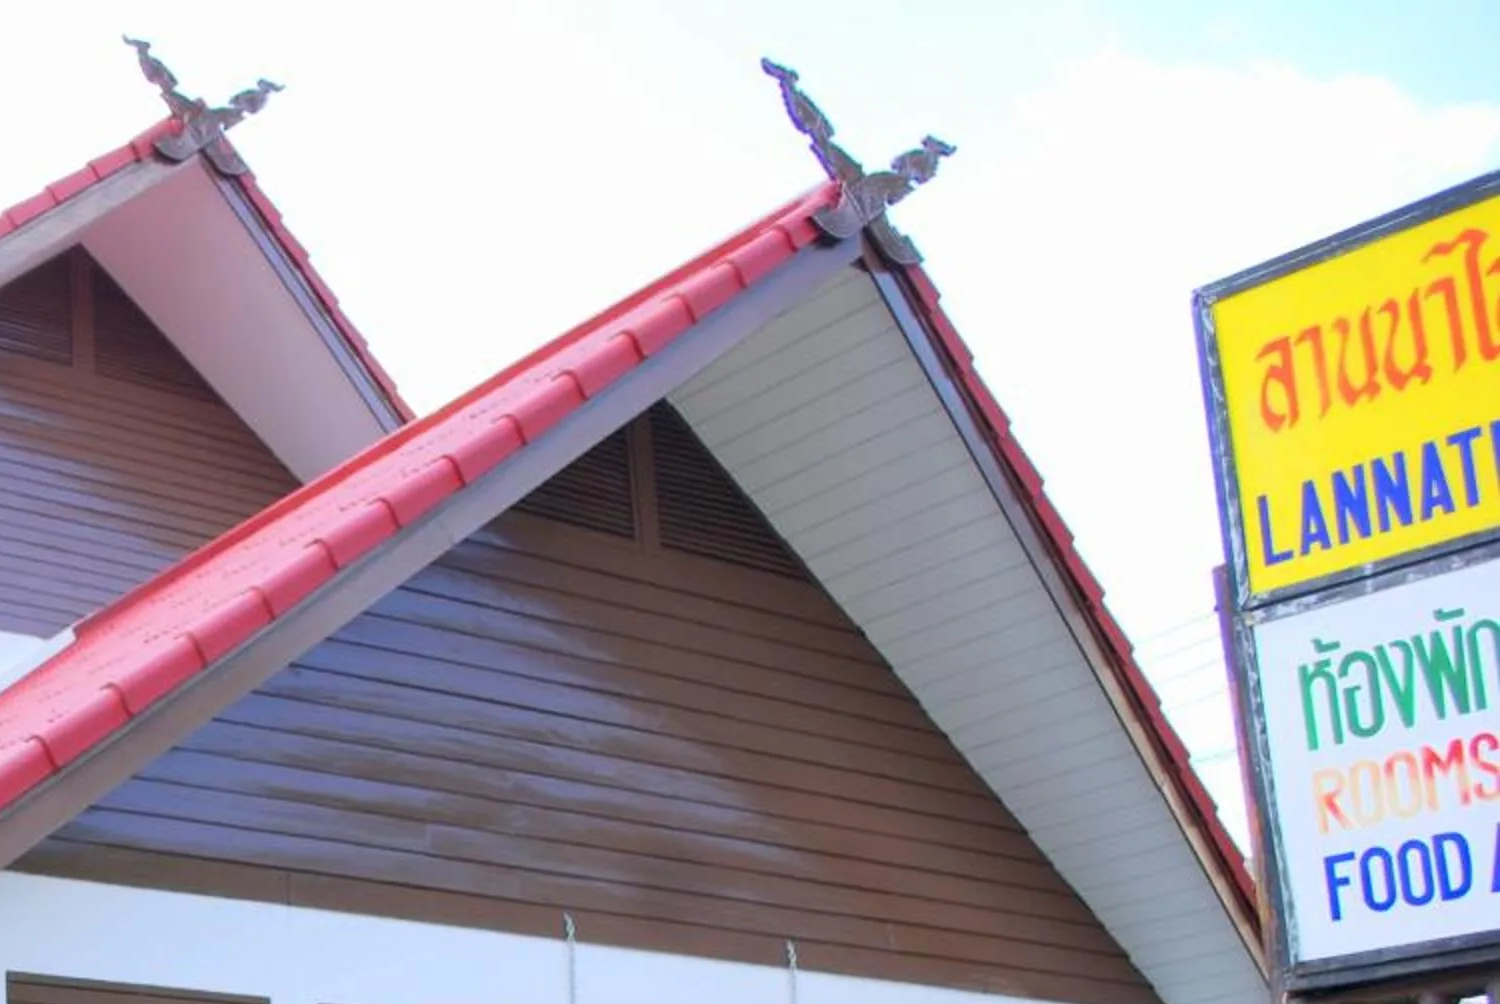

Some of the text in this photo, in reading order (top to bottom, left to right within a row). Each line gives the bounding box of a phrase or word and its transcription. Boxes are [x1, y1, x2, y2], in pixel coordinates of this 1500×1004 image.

[1256, 228, 1500, 433] ลานนาไ
[1313, 733, 1500, 833] ROOMS
[1324, 832, 1472, 921] FOOD
